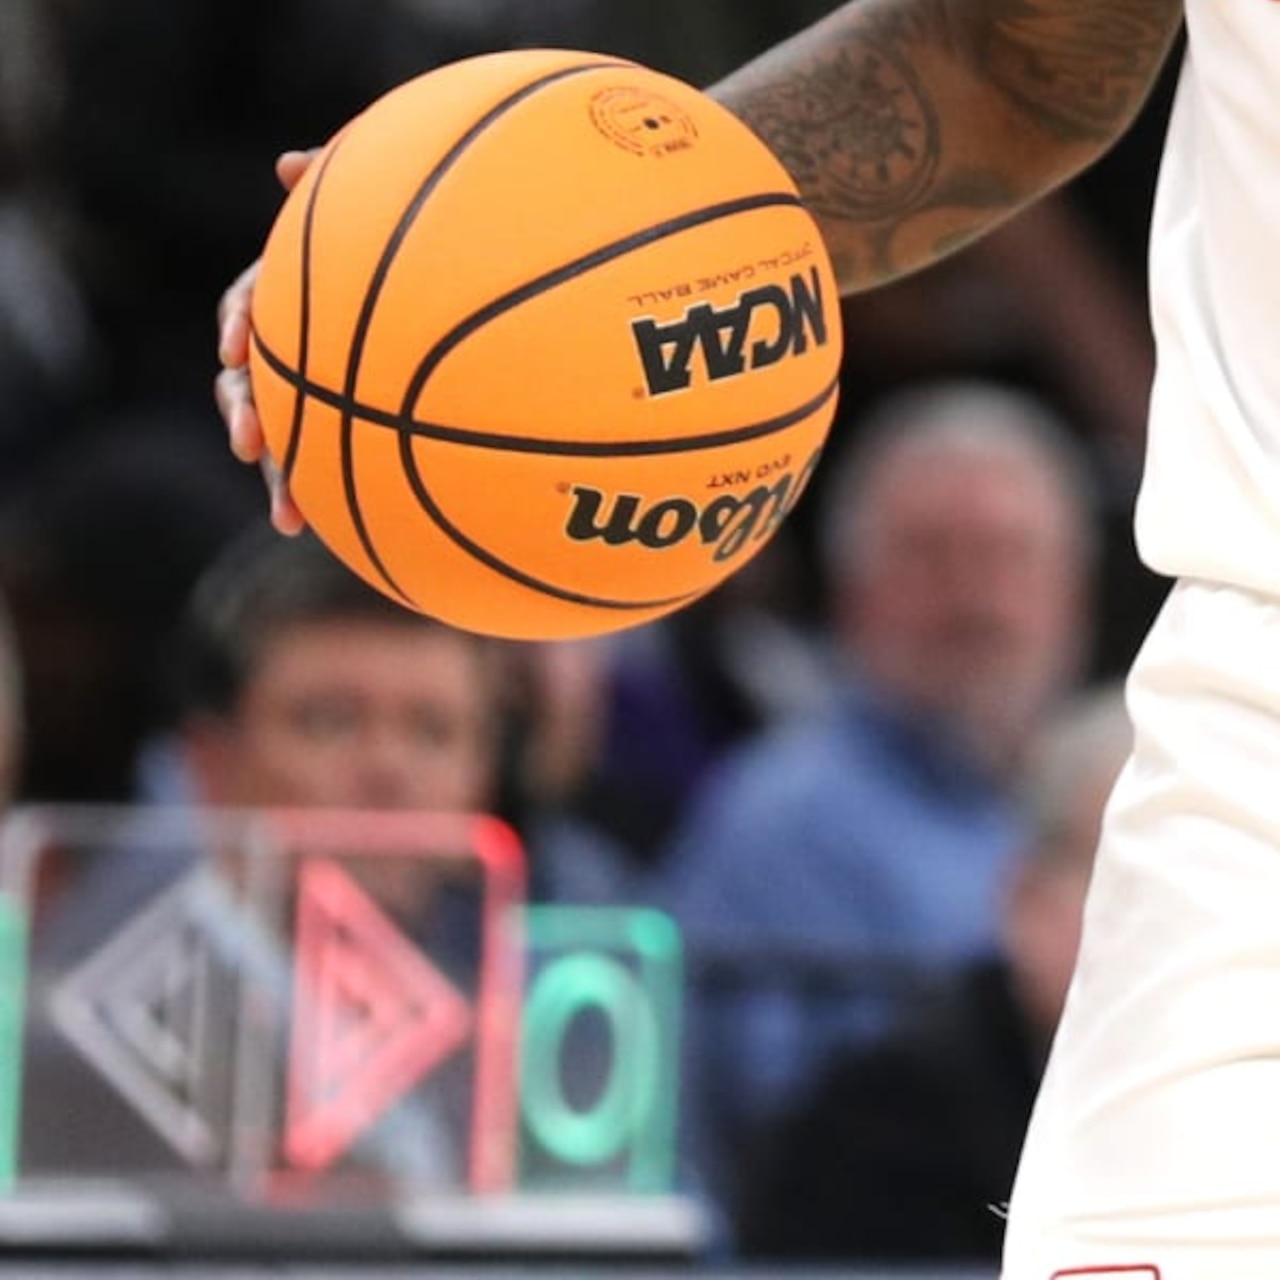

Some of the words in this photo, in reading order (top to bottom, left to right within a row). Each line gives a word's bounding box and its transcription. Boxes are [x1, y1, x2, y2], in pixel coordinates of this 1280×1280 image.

[697, 266, 756, 293] GAME
[627, 282, 691, 308] BALL
[631, 265, 828, 398] NCAA
[706, 469, 752, 489] NXT
